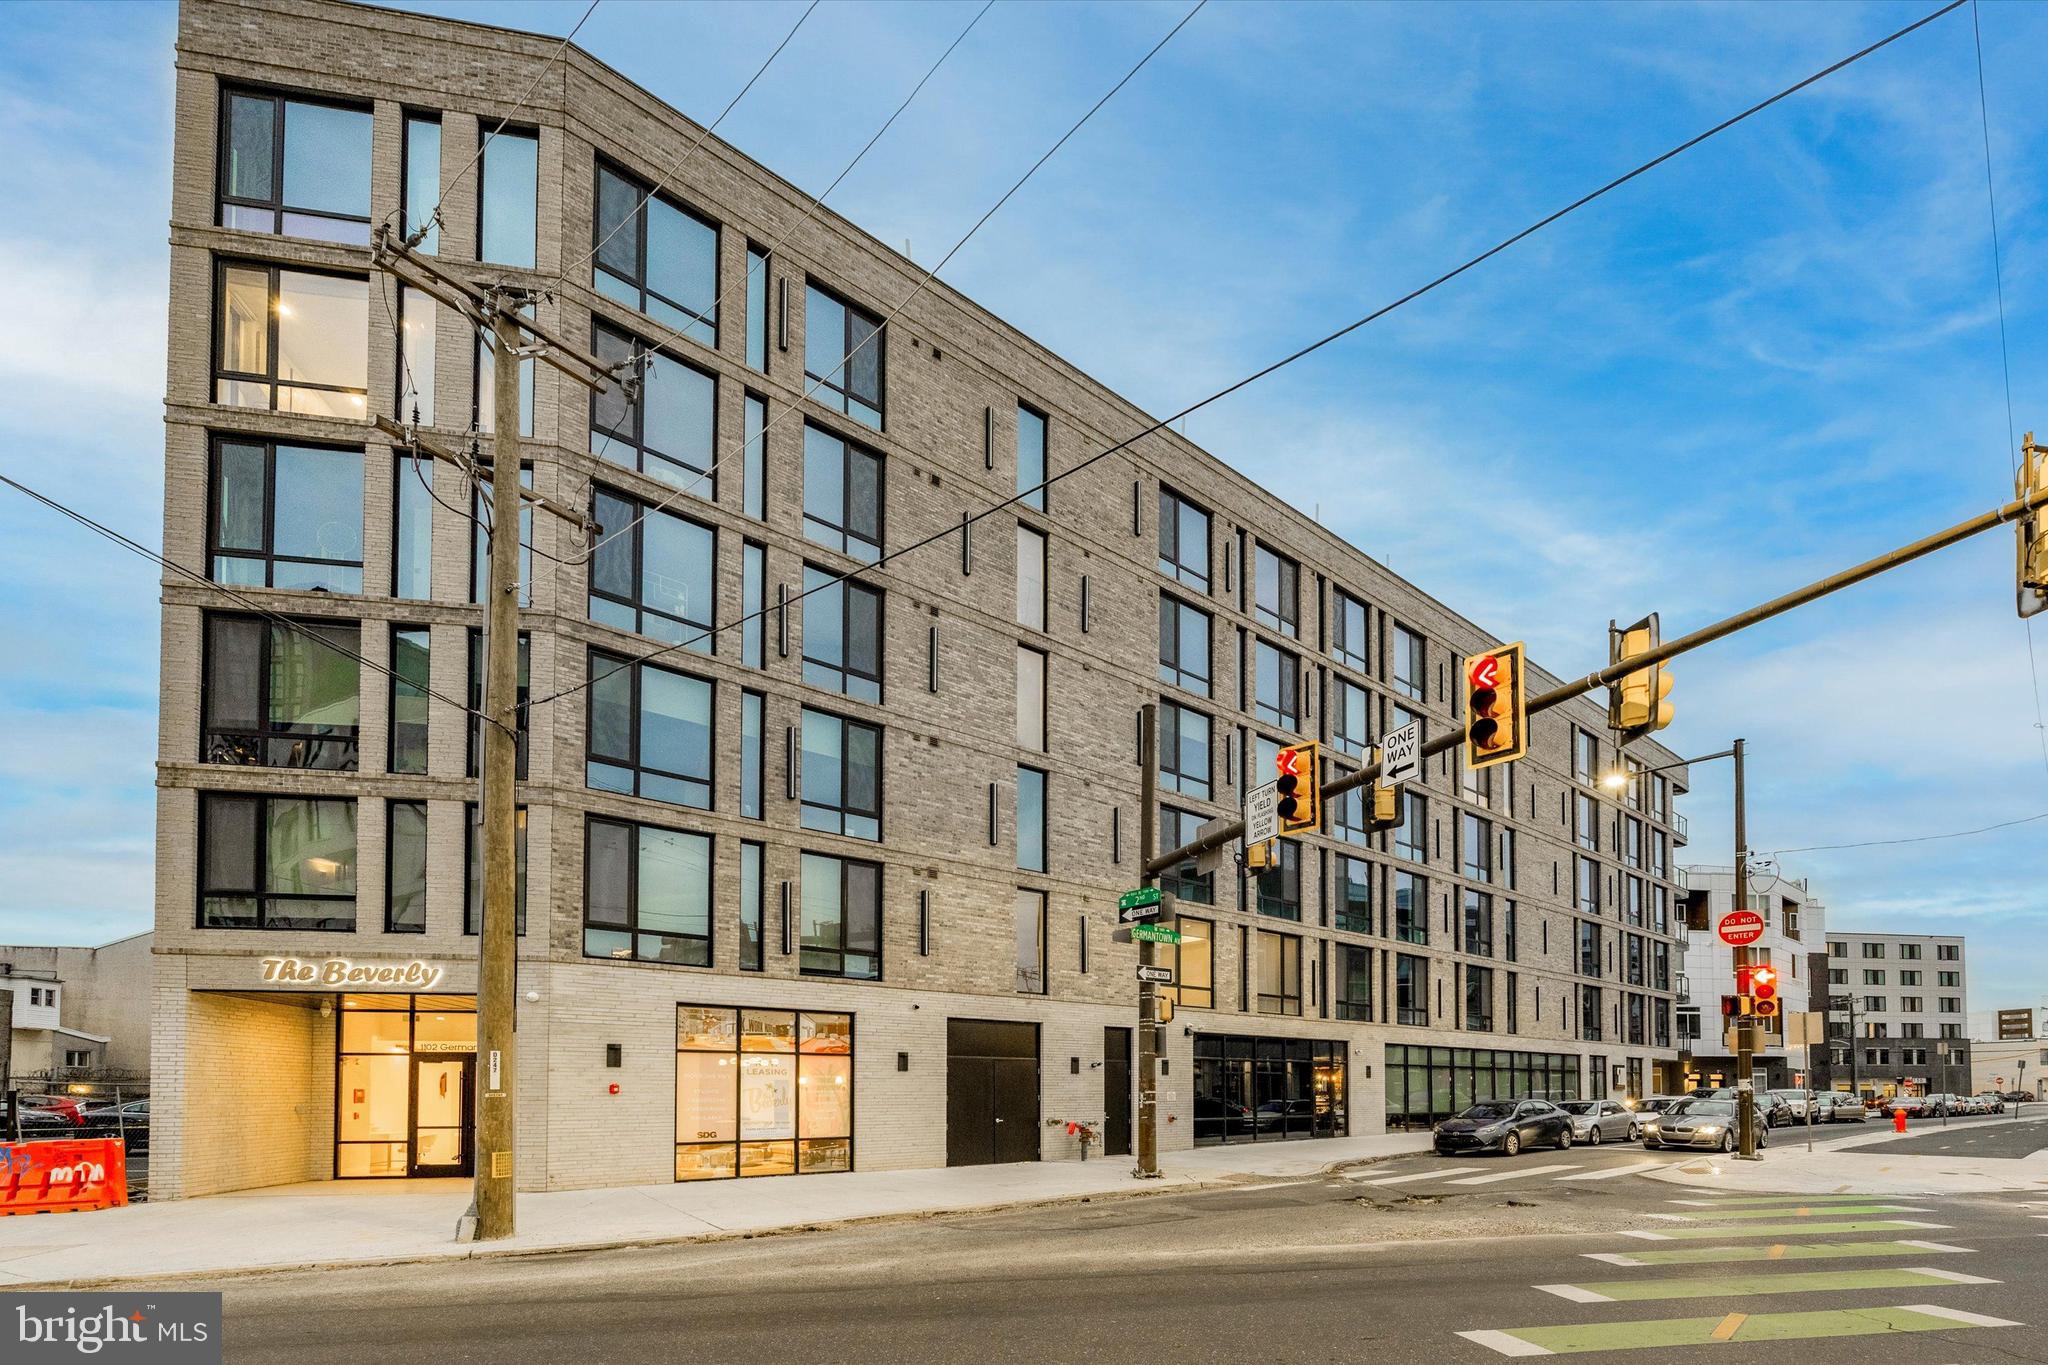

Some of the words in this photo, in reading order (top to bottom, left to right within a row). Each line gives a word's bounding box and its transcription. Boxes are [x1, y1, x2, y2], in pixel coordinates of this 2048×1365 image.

[1386, 726, 1415, 749] ONE
[1386, 743, 1415, 764] WAY
[1249, 791, 1261, 804] LEFT
[1261, 785, 1276, 798] TURN
[1253, 797, 1271, 812] YIELD
[1252, 815, 1273, 830] YELLOW
[1253, 826, 1272, 839] ARROW
[1152, 893, 1159, 901] ST
[1131, 908, 1143, 917] ONE
[1740, 916, 1757, 924] NOT
[1131, 928, 1173, 944] GERMANTOWN
[1728, 932, 1754, 940] ENTER
[262, 959, 315, 981] The
[321, 960, 441, 988] Beverly
[1146, 970, 1157, 978] ONE
[421, 1043, 438, 1051] 1102
[746, 1067, 788, 1076] LEASING
[697, 1131, 717, 1139] SDG
